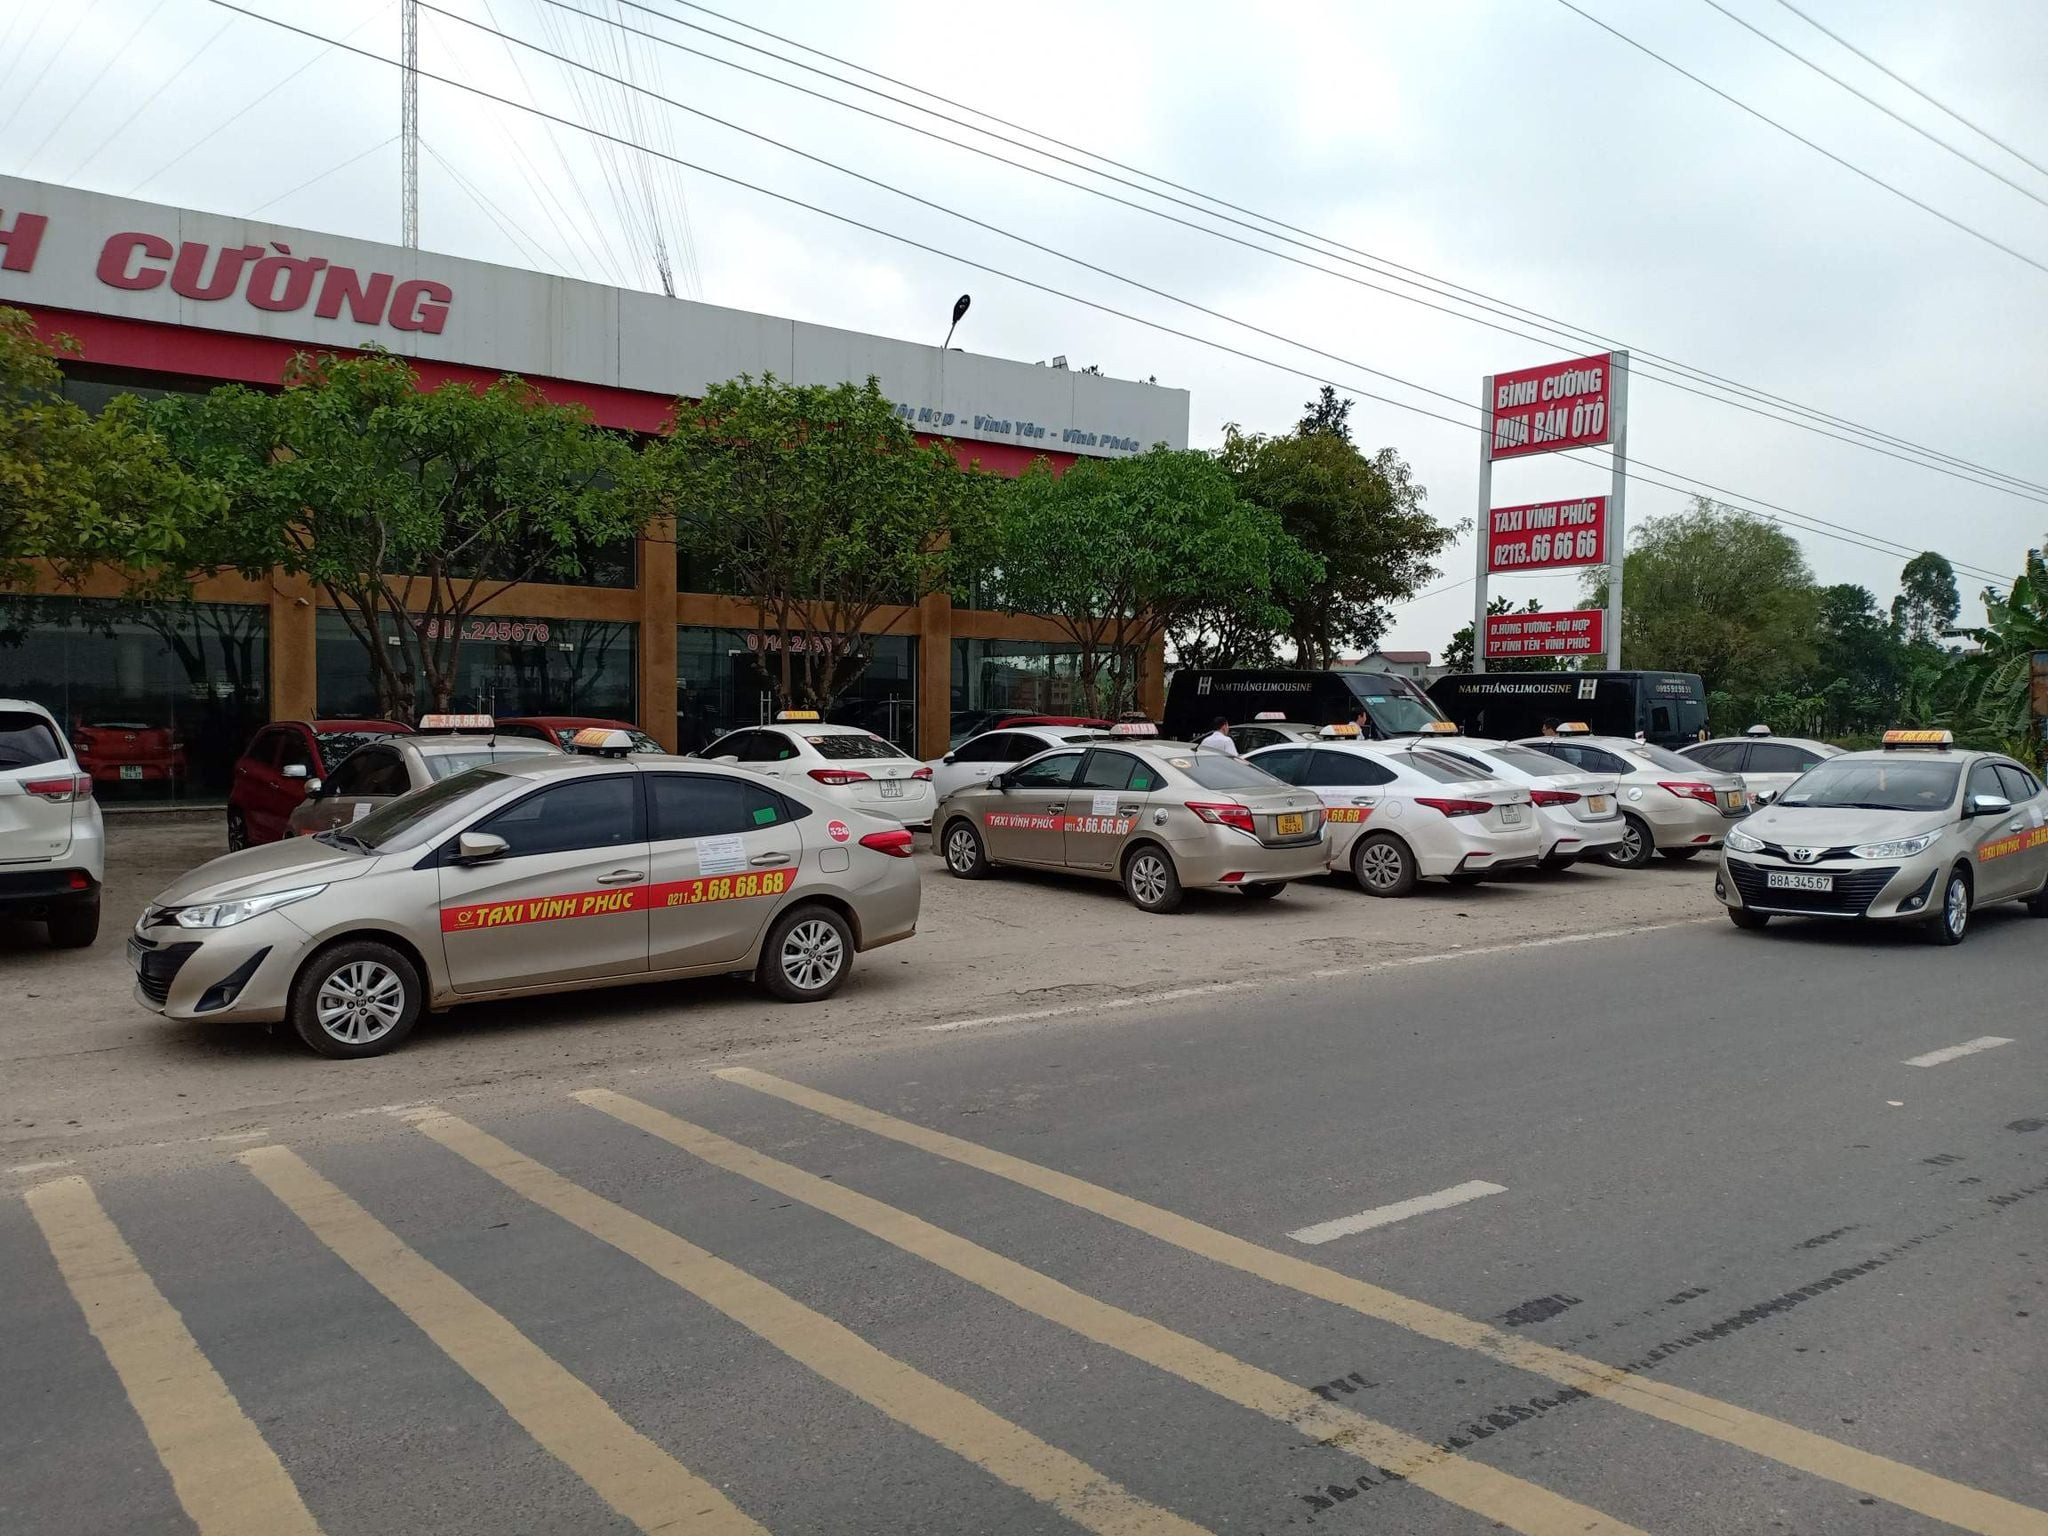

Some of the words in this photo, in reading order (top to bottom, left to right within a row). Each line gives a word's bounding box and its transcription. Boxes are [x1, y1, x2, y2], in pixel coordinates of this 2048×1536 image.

[96, 232, 453, 335] CƯỜNG
[1498, 380, 1539, 409] BÌNH
[1542, 368, 1603, 400] CƯỜNG
[1015, 420, 1046, 439] Yên
[1100, 434, 1141, 452] Phúc
[1494, 414, 1529, 450] MUA
[1533, 403, 1569, 444] BÁN
[1572, 395, 1605, 438] ÔTÔ
[1495, 511, 1524, 533] TAXI
[1526, 504, 1557, 530] VĨNH
[1560, 499, 1597, 527] PHÚC
[1494, 534, 1551, 566] 02113.66
[1553, 531, 1574, 560] 66
[1576, 529, 1597, 558] 66
[1261, 682, 1313, 692] LIMOUSINE
[1458, 685, 1480, 694] NAM
[1514, 684, 1572, 694] LIMOUSINE
[989, 815, 1008, 826] TAXI
[1031, 815, 1055, 829] PHÚC
[476, 904, 524, 927] TAXI
[529, 897, 578, 920] VĨNH
[582, 890, 634, 914] PHÚC
